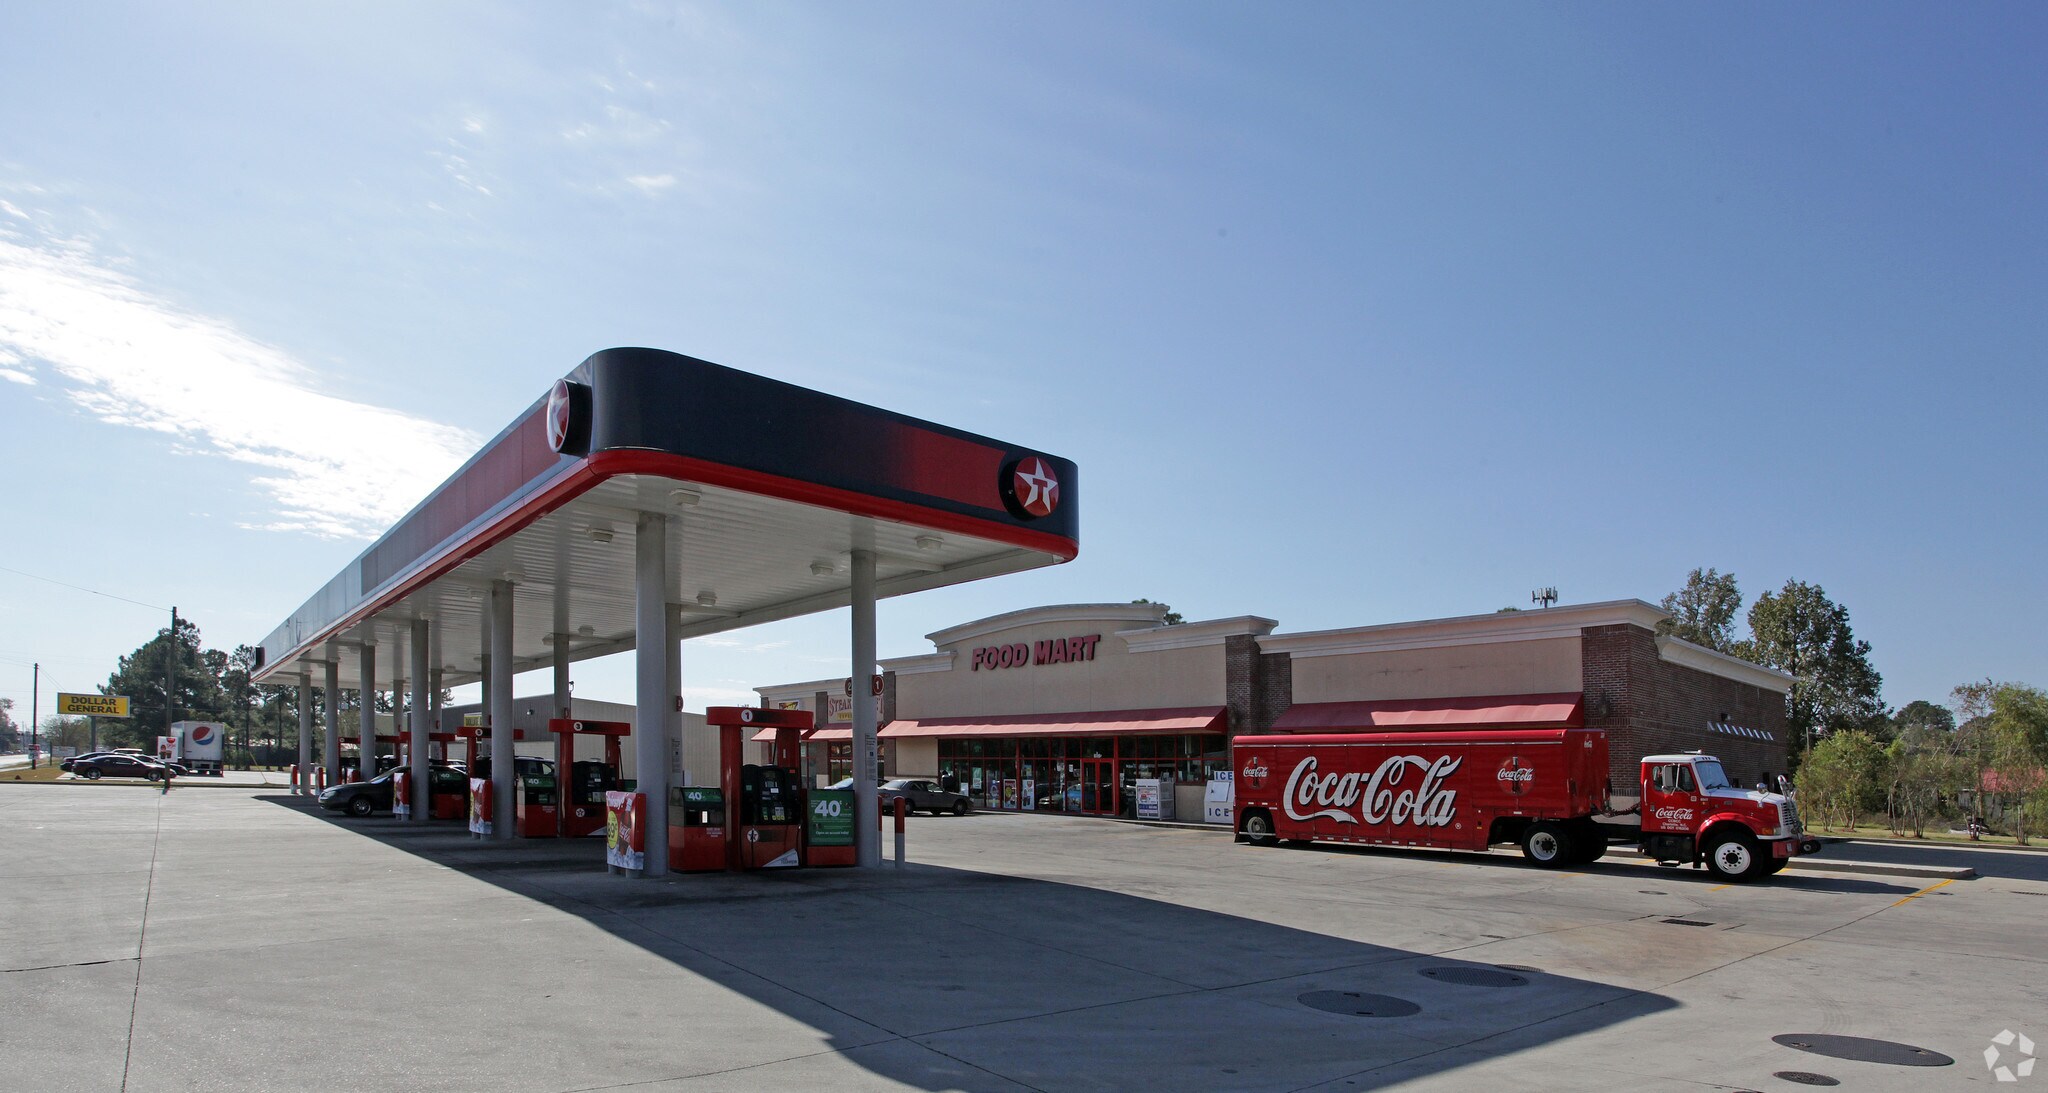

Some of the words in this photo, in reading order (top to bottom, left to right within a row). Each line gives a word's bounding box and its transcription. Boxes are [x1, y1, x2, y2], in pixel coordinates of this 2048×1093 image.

[971, 643, 1029, 671] FOOD
[1033, 634, 1101, 665] MART
[71, 696, 117, 706] DOLLAR
[67, 704, 120, 714] GENERAL
[1215, 771, 1233, 780] ICE
[1243, 766, 1268, 777] Coca-Cola
[1497, 768, 1534, 781] Coca-Cola
[1283, 755, 1463, 827] Coca-Cola
[1208, 808, 1229, 816] ICE
[1656, 808, 1693, 819] Coca-Cola
